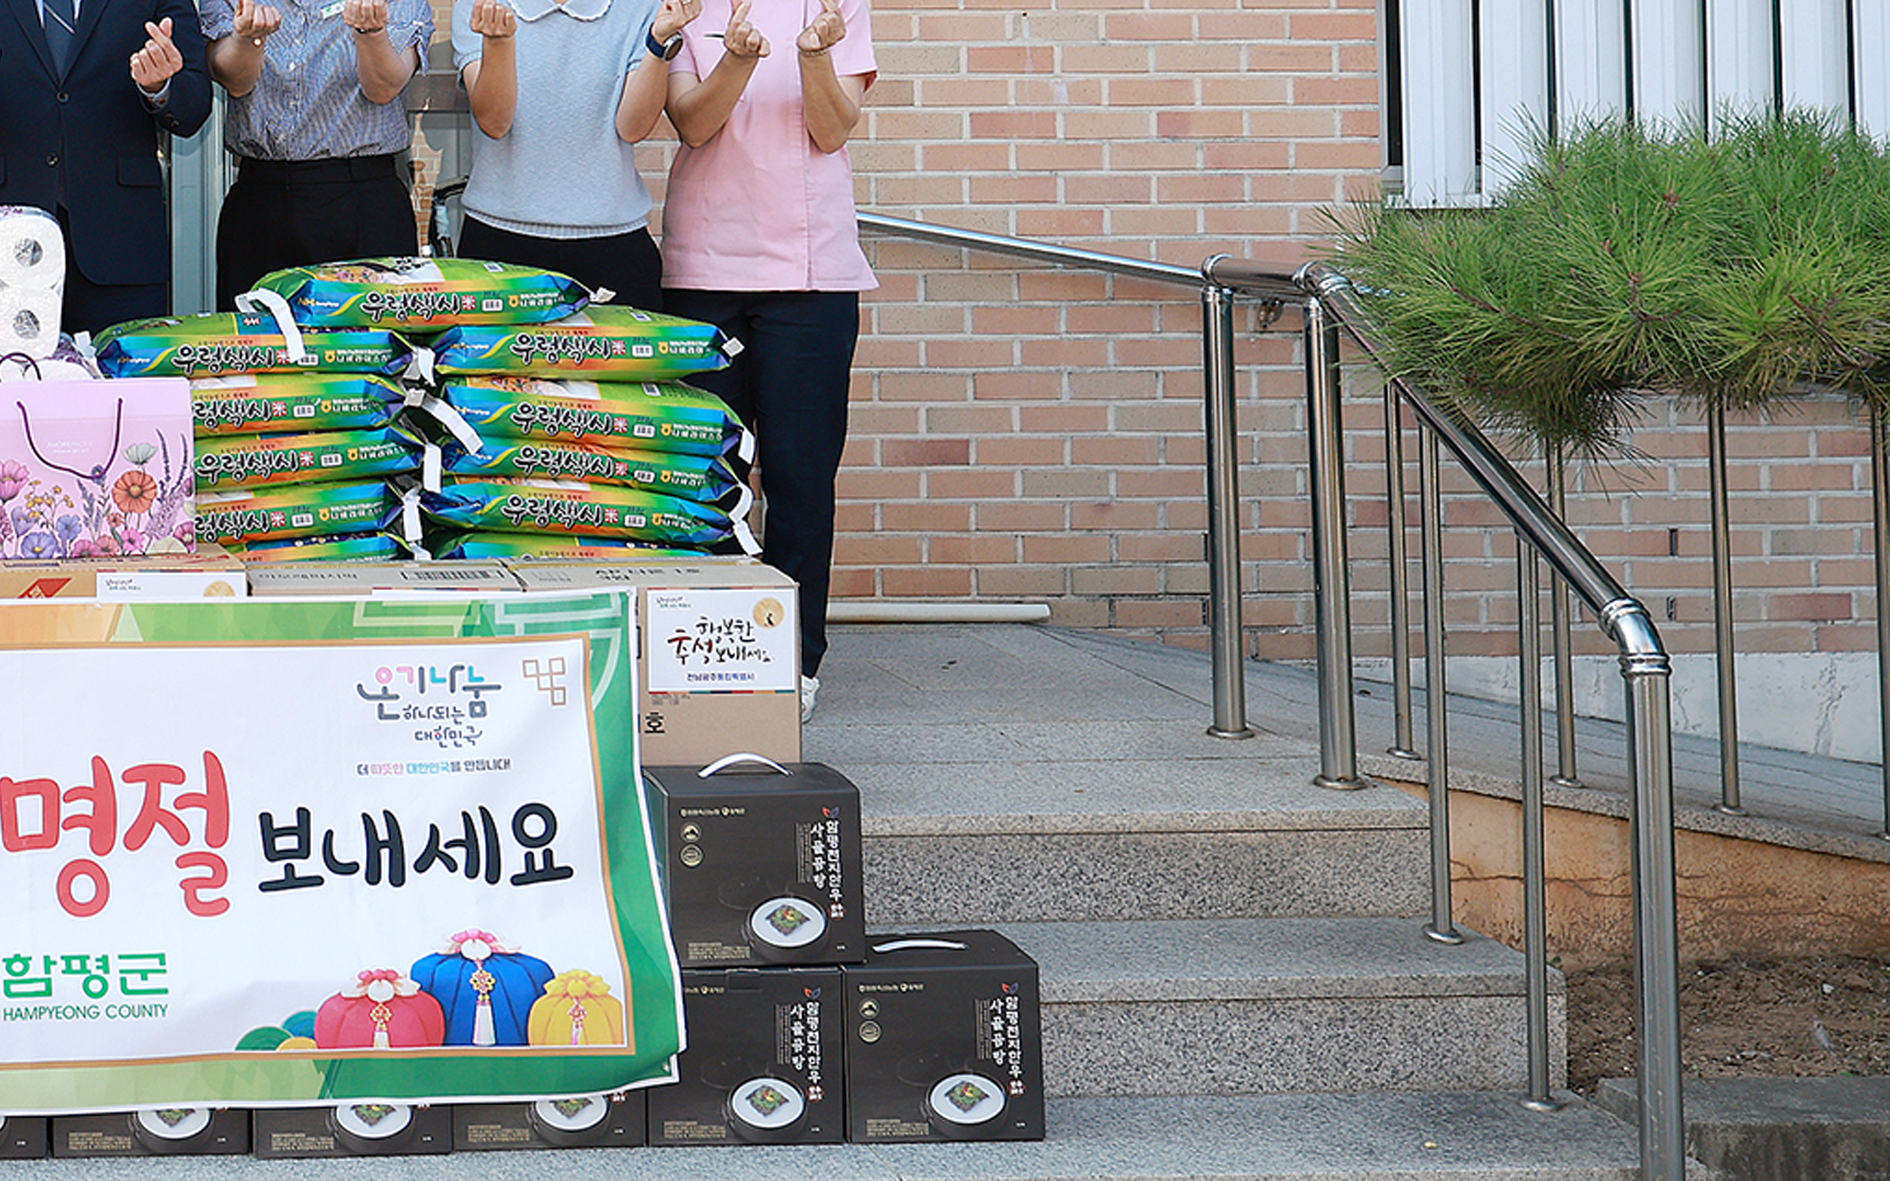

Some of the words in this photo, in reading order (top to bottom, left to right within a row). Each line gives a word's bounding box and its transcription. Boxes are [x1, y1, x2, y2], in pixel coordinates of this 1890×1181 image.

[194, 399, 272, 428] 렁색시
[194, 510, 271, 541] 렁색시
[696, 616, 756, 644] 행복한
[667, 629, 714, 667] 추석
[356, 664, 503, 721] 온기나눔
[402, 704, 466, 726] 하나되는
[644, 711, 666, 735] 호
[413, 725, 484, 749] 대한민국
[356, 763, 369, 776] 더
[370, 762, 405, 775] 따뜻한
[406, 760, 462, 775] 대한민국을
[257, 802, 575, 893] 보내세요
[2, 951, 170, 1000] 함평군
[2, 1004, 101, 1022] HAMPYEONG
[104, 1003, 170, 1021] COUNTY
